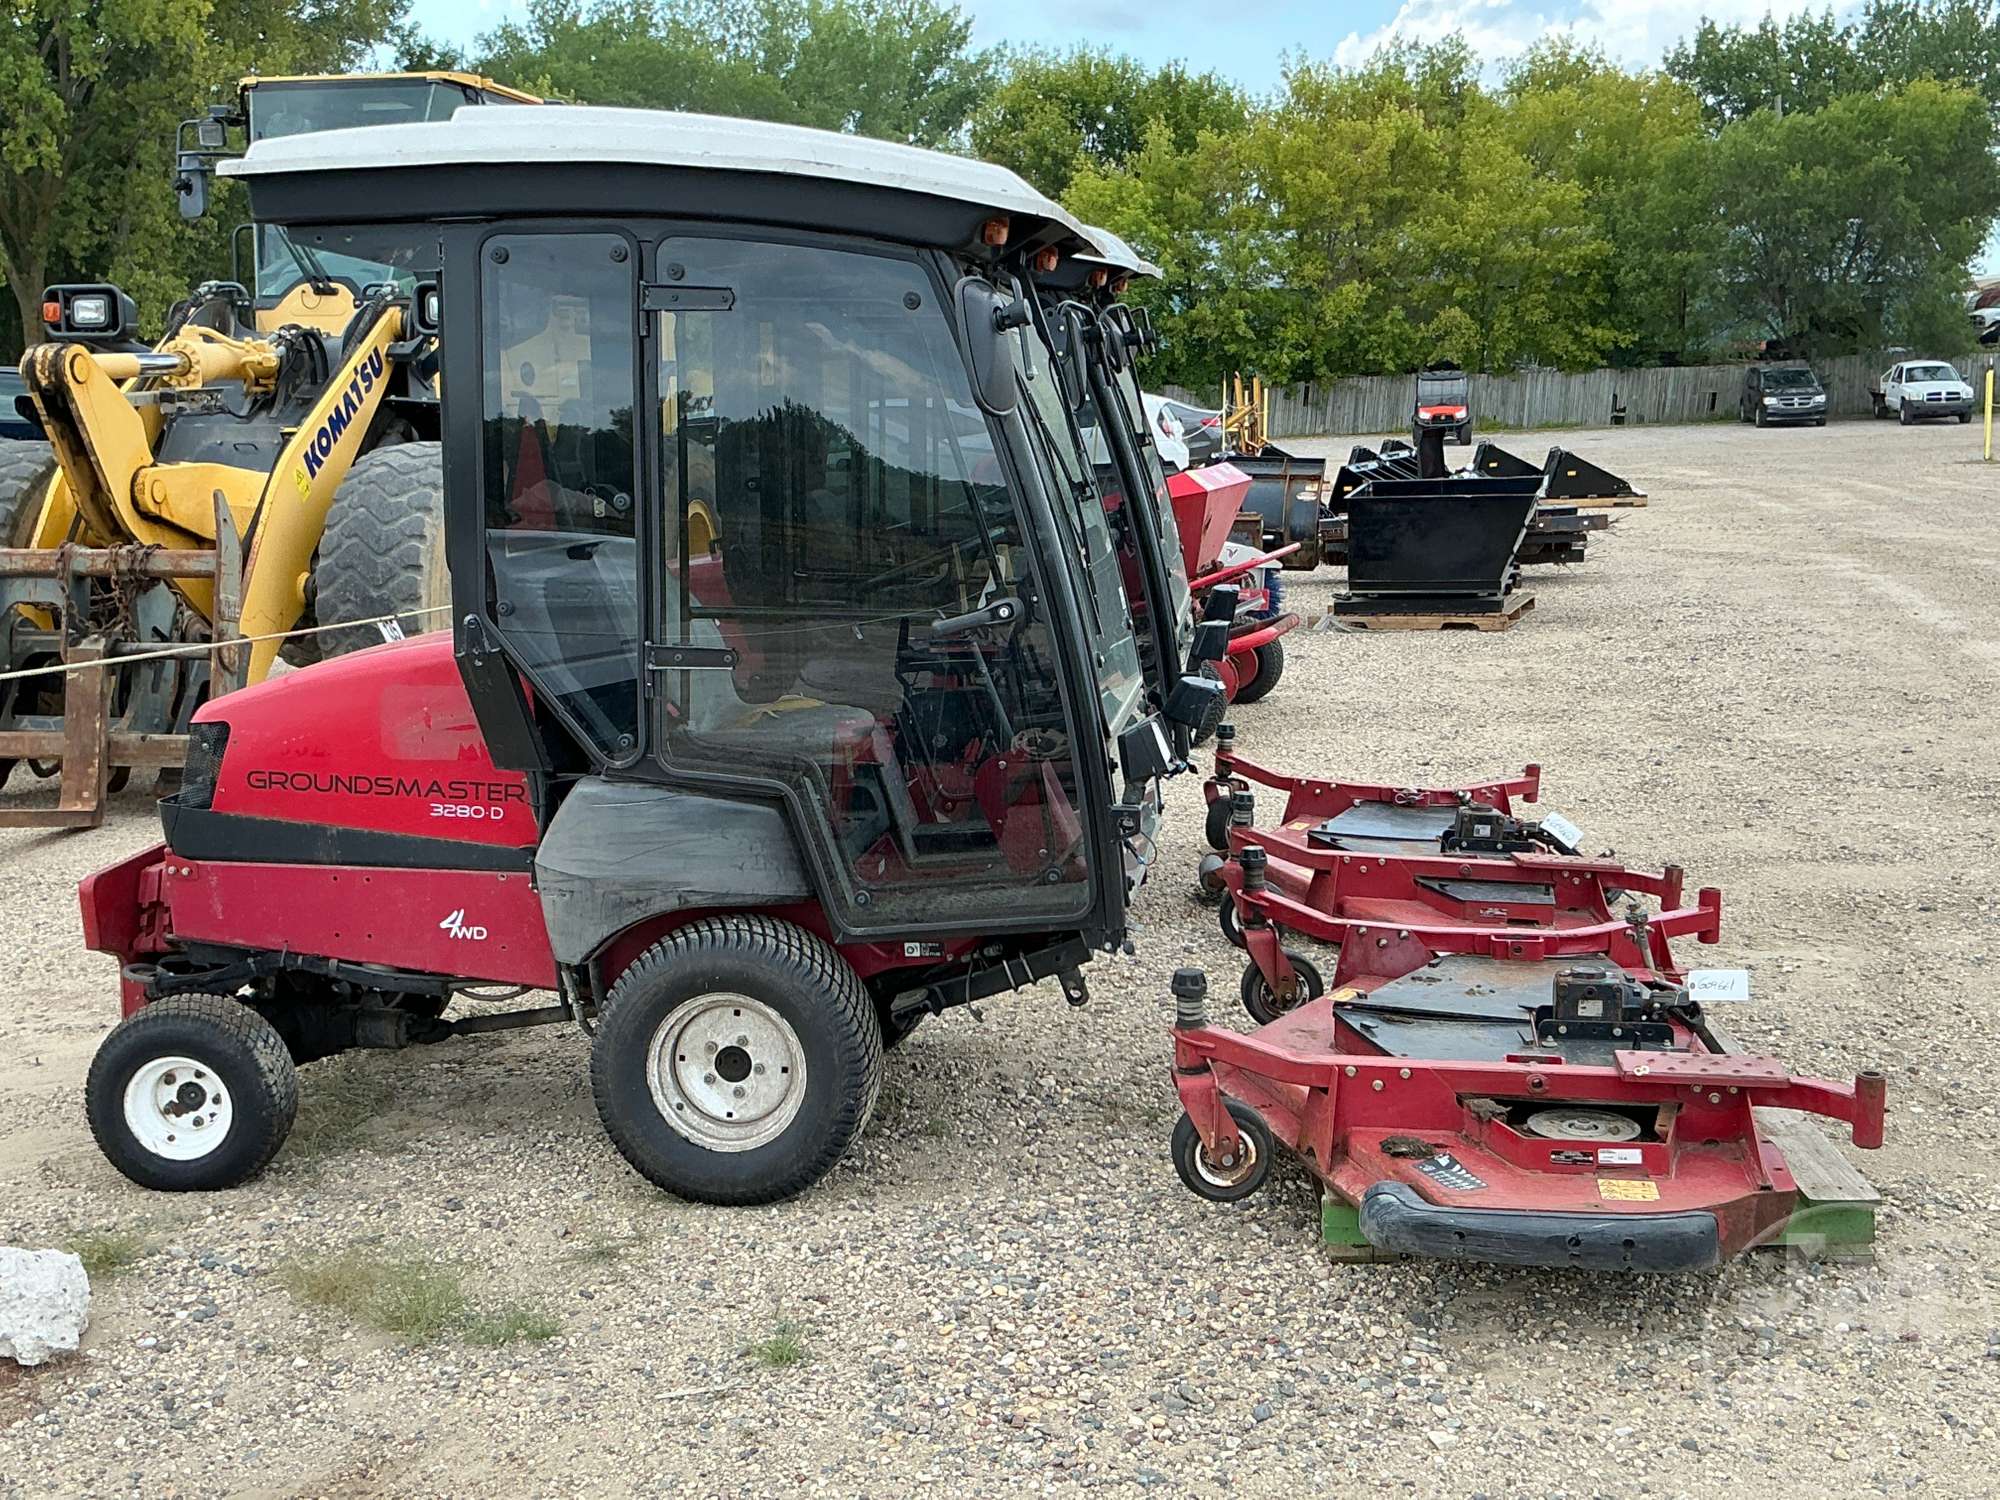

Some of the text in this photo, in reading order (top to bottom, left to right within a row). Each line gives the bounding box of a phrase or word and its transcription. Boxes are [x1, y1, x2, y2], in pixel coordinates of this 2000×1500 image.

[303, 346, 384, 480] KOMATSU
[246, 770, 526, 803] GROUNDSMASTER
[439, 908, 488, 941] 4WD
